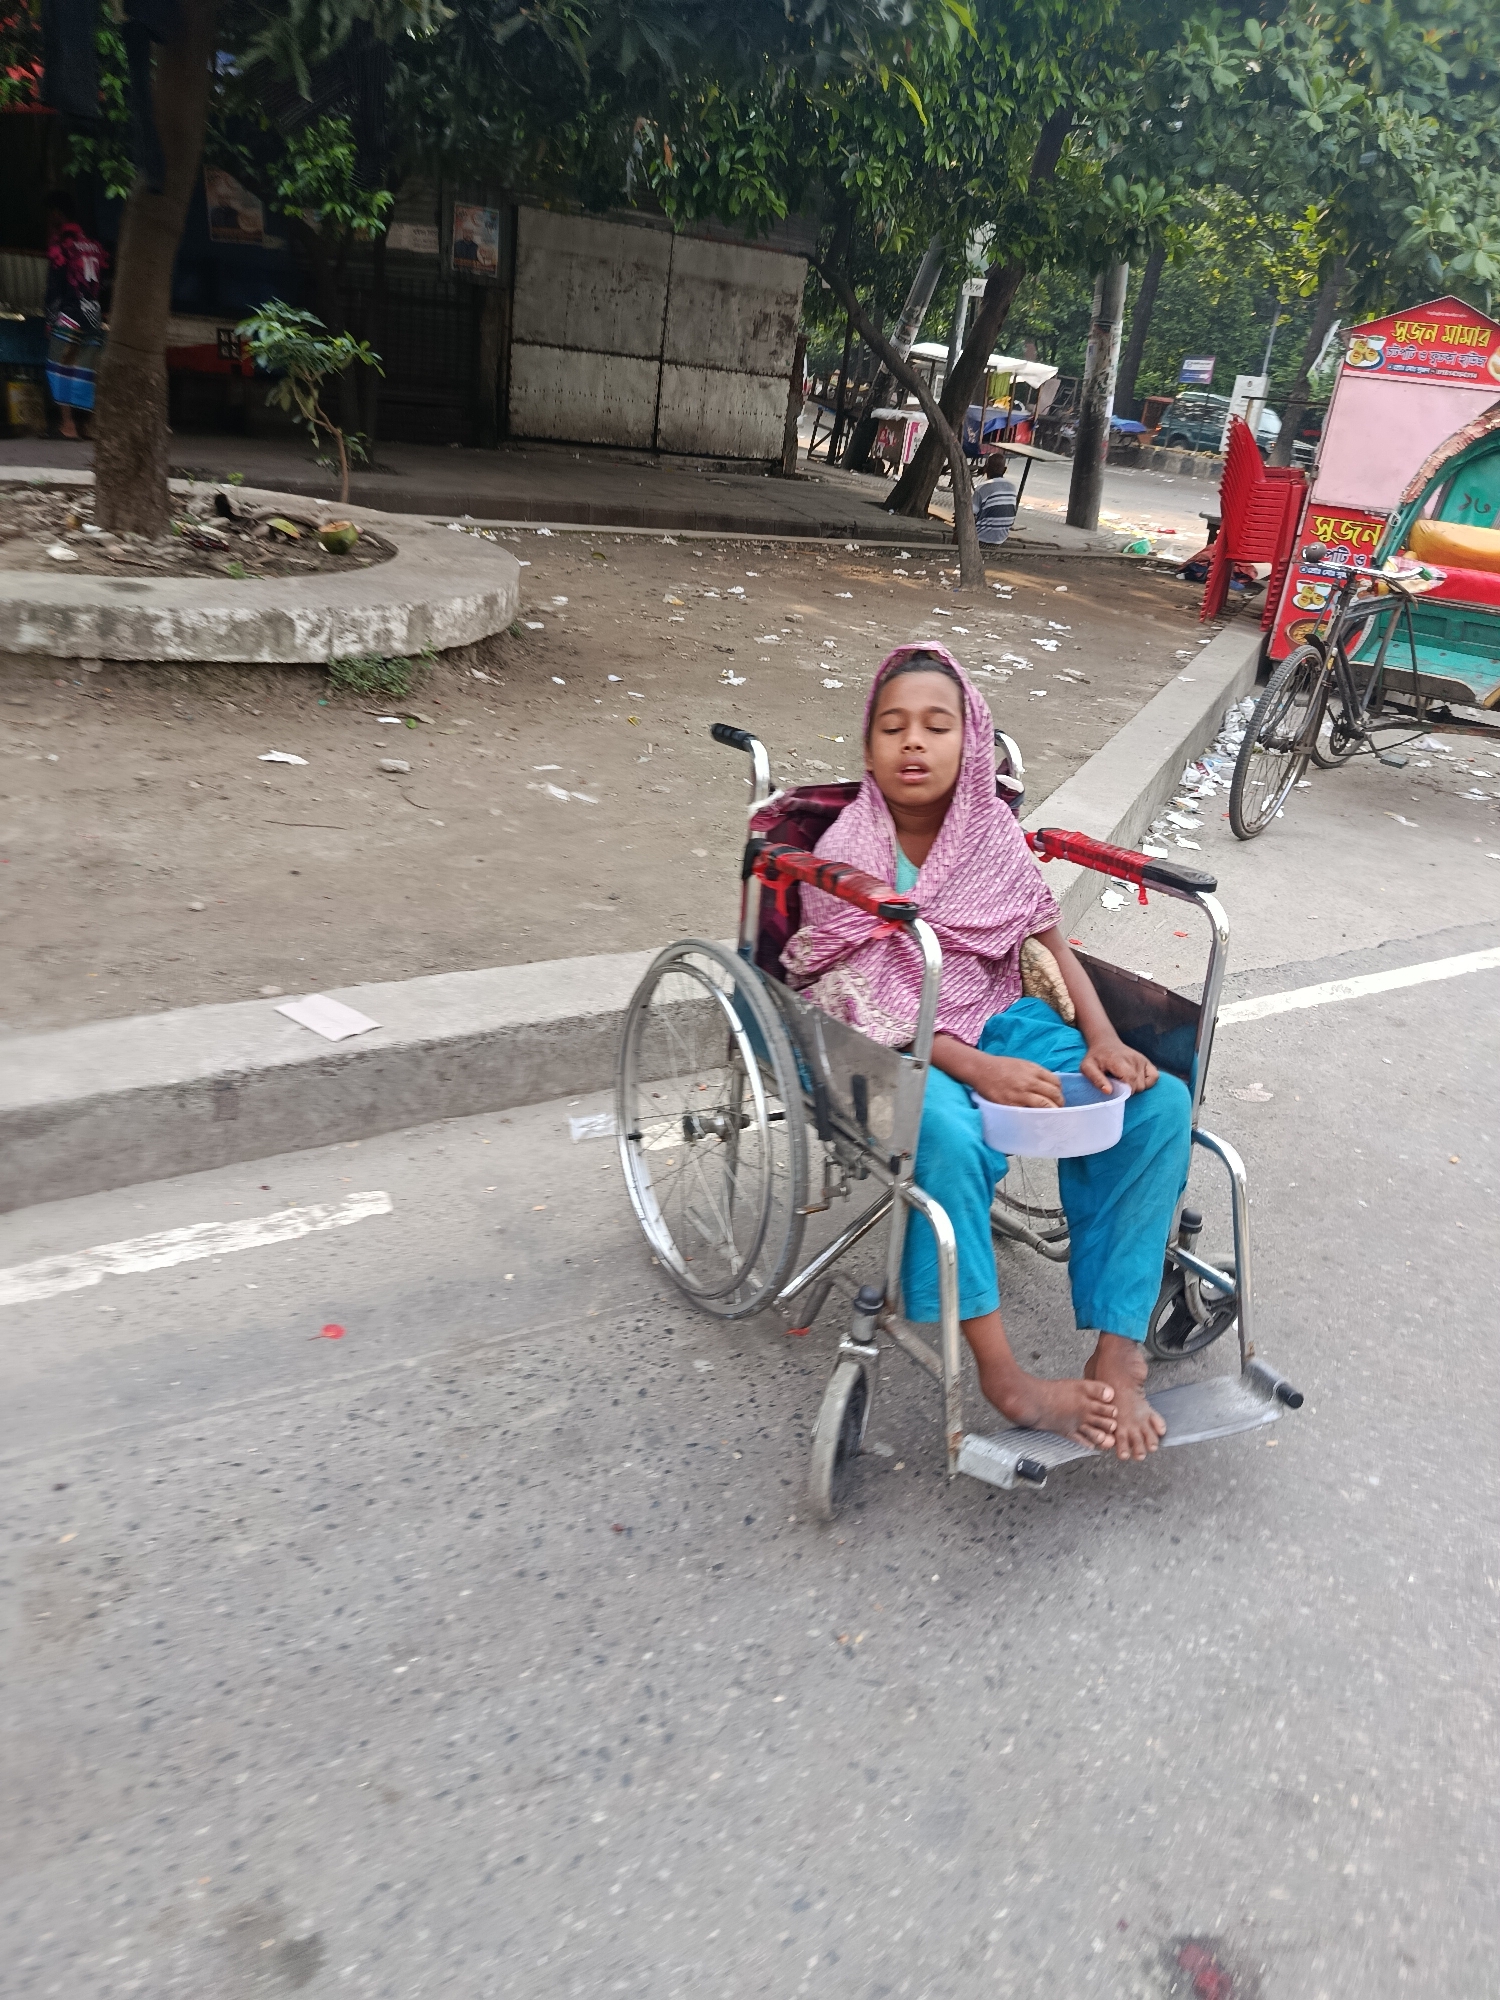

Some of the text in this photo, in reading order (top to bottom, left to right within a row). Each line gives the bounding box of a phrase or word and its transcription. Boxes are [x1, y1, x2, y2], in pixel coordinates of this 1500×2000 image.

[1391, 320, 1493, 347] সুজন মামার
[1309, 515, 1384, 548] সুজন
